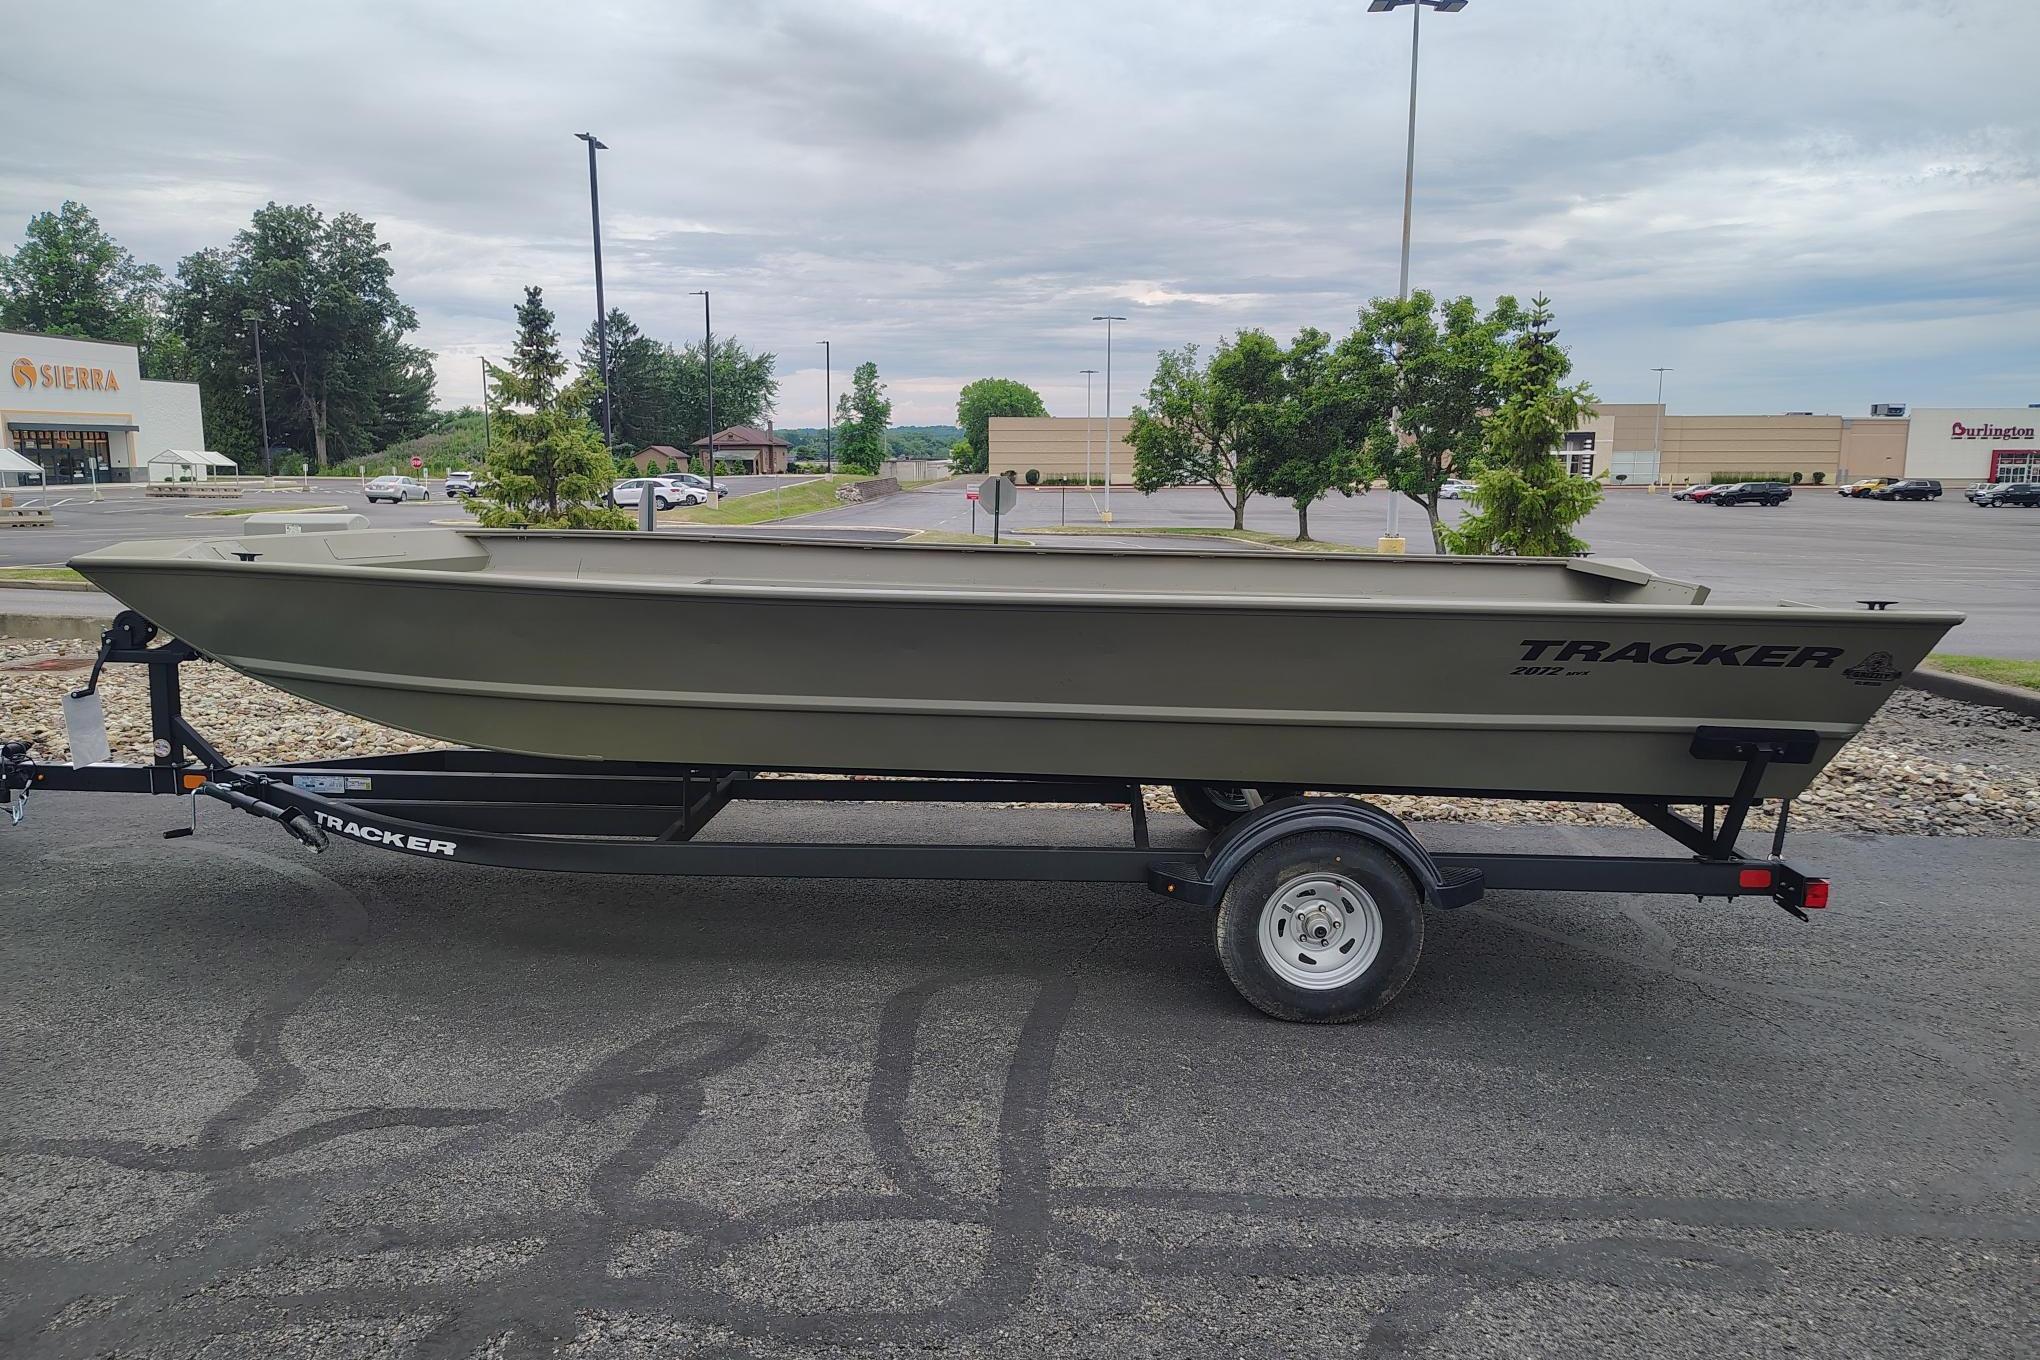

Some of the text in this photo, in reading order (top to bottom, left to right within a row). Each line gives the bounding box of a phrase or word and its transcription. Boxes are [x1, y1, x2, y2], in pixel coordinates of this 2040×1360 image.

[41, 363, 120, 391] SIERRA
[1951, 422, 2035, 440] Burlington
[1520, 639, 1846, 669] TRACKER
[1509, 666, 1564, 676] 2072
[314, 810, 458, 856] TRACKER
